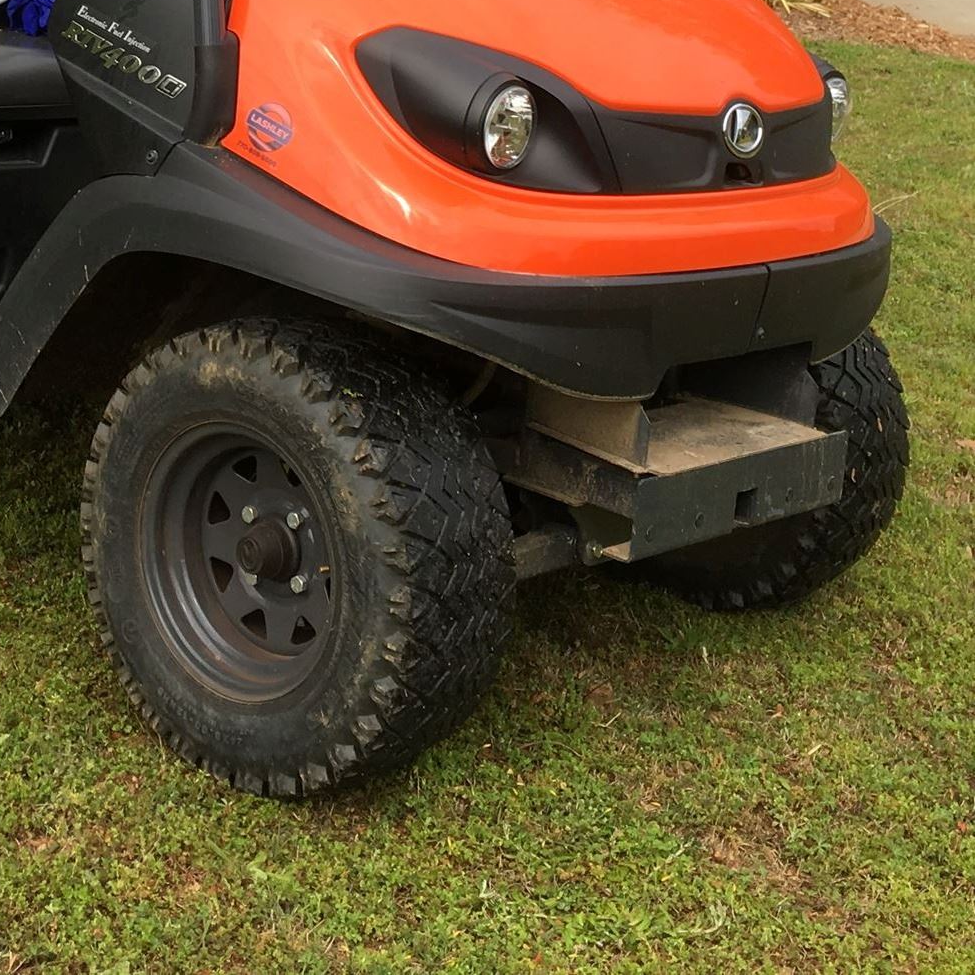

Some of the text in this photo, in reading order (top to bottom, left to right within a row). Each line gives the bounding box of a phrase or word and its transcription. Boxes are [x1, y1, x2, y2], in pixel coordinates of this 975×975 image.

[76, 4, 152, 54] Electronic Fuel Injection
